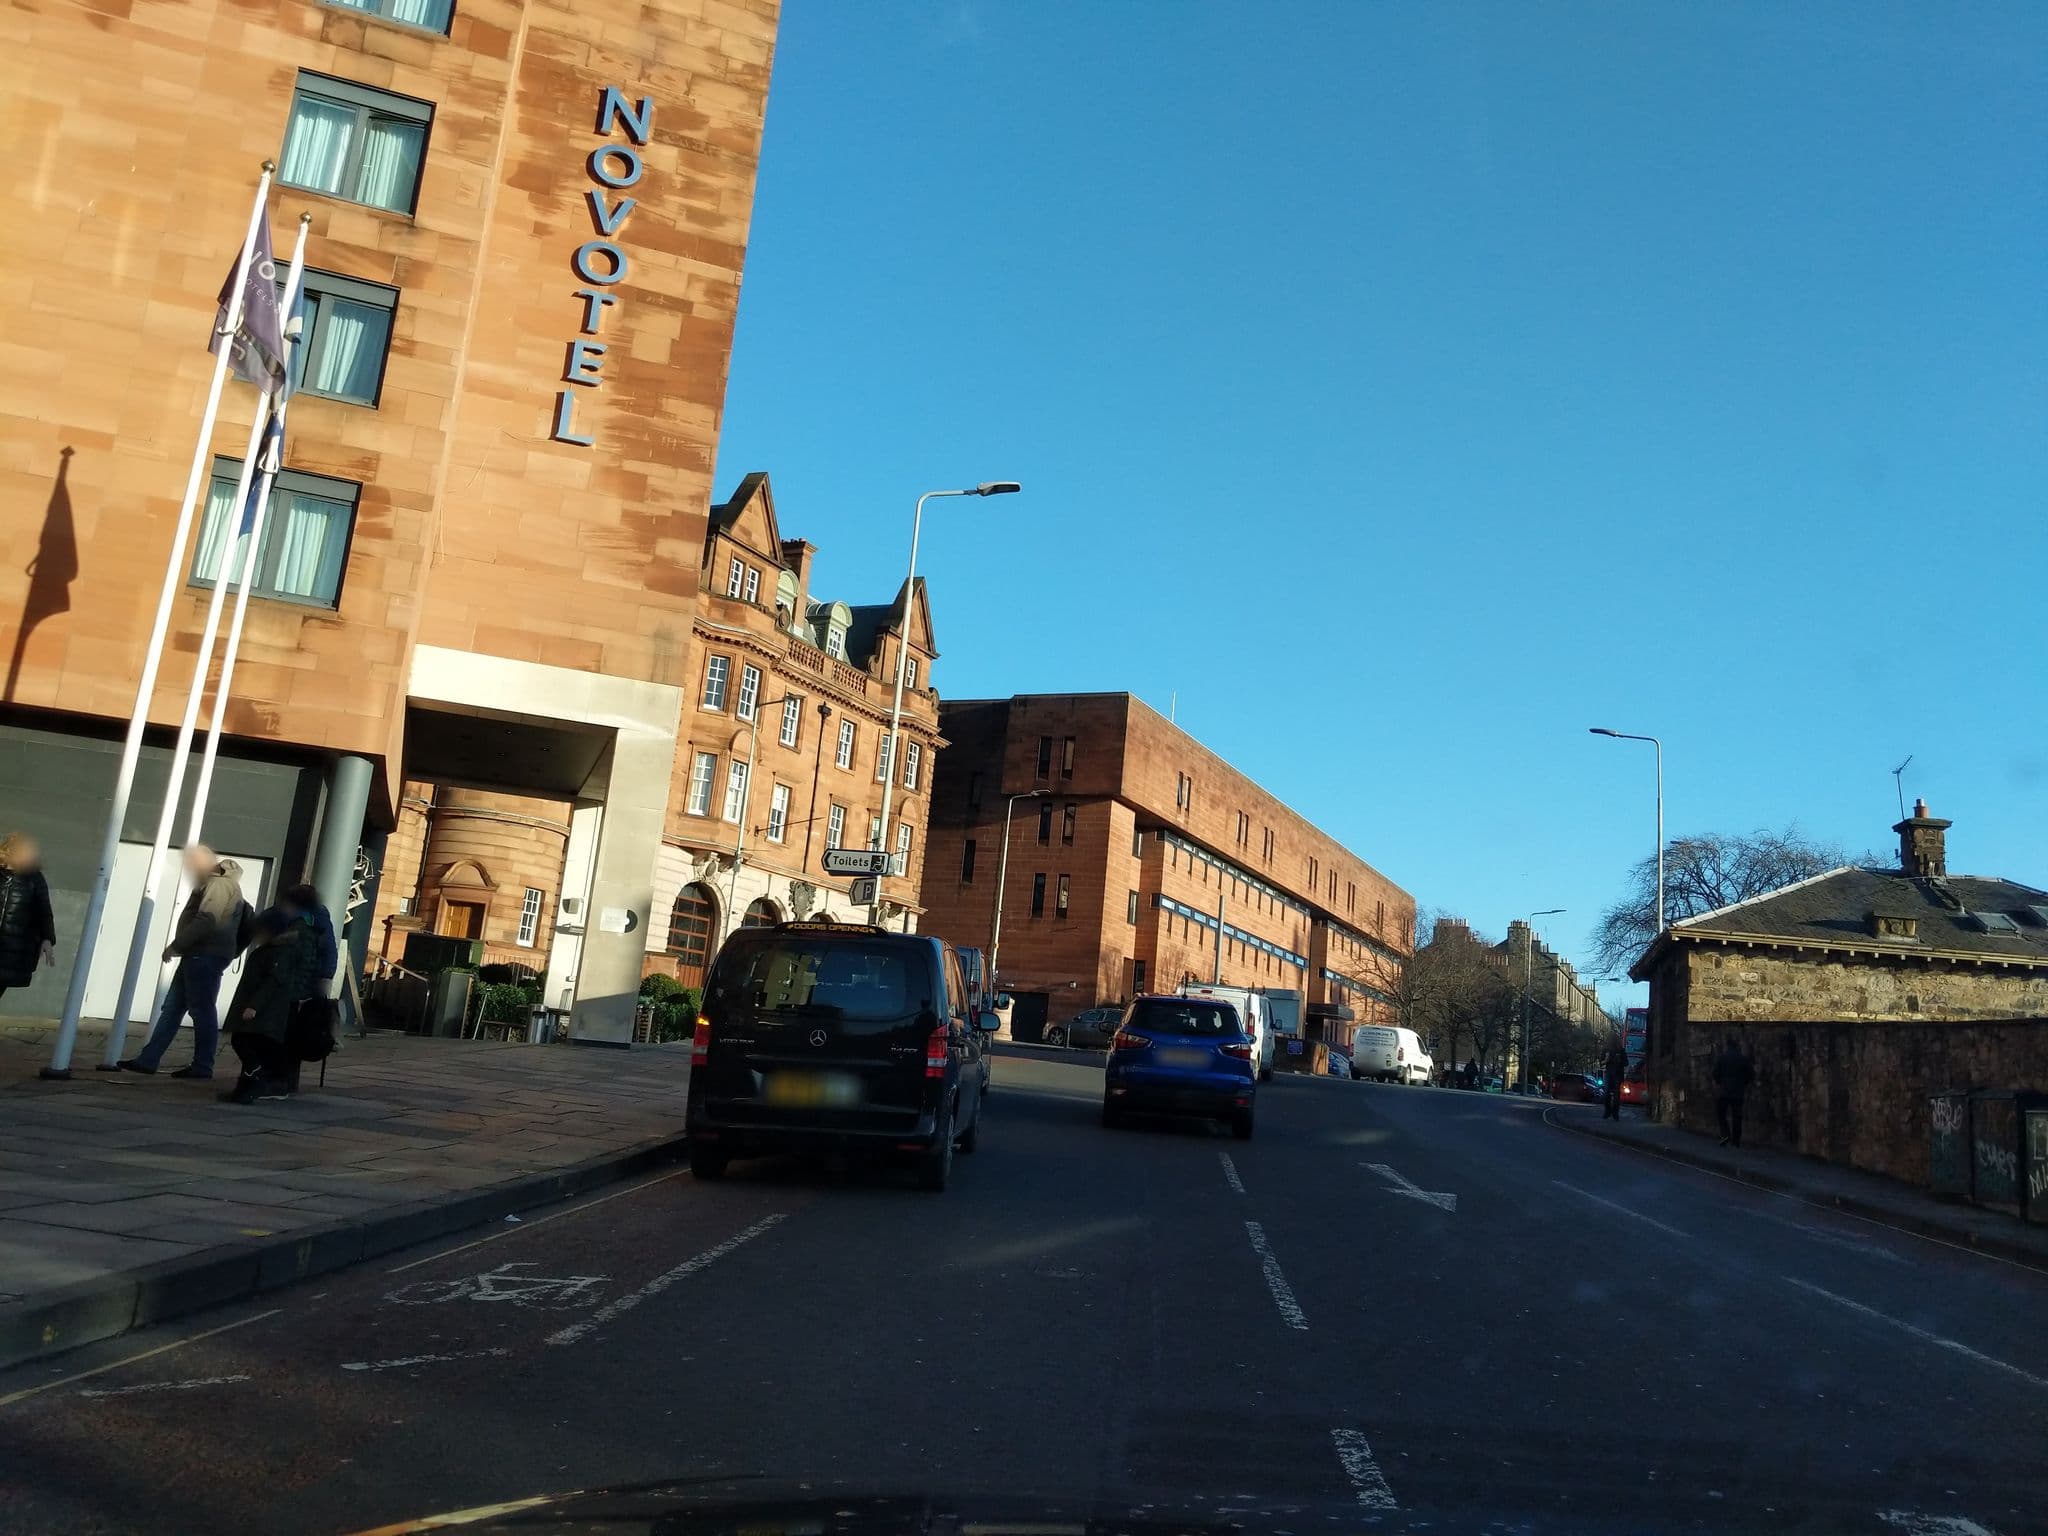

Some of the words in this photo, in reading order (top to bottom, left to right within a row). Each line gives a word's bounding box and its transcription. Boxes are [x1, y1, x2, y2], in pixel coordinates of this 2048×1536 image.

[550, 84, 653, 446] NOVOTEL
[245, 278, 274, 307] OTELS
[833, 855, 869, 867] Toilets
[864, 884, 872, 899] P
